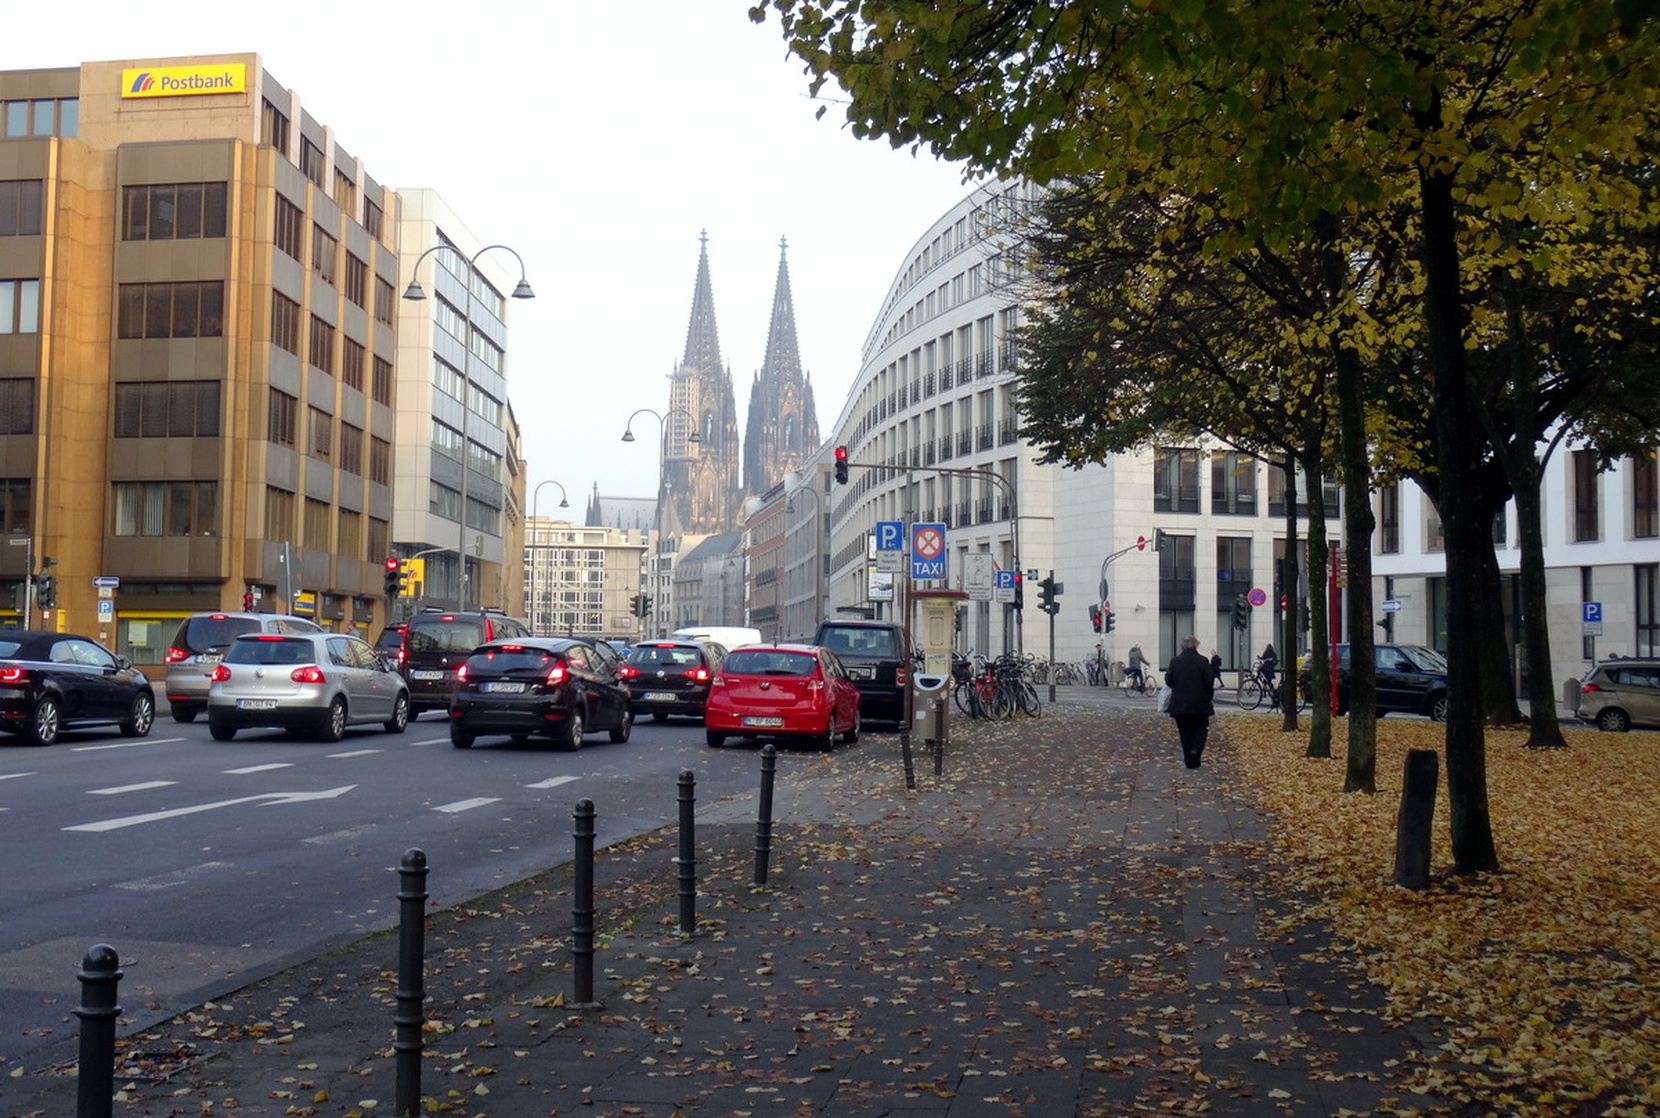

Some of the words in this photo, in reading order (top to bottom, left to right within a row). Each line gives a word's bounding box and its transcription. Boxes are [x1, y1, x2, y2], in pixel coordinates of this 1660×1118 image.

[161, 72, 233, 91] Postbank
[882, 525, 897, 549] P
[913, 562, 944, 575] TAXI
[1001, 573, 1011, 588] P
[101, 602, 110, 613] P
[1587, 604, 1598, 620] P
